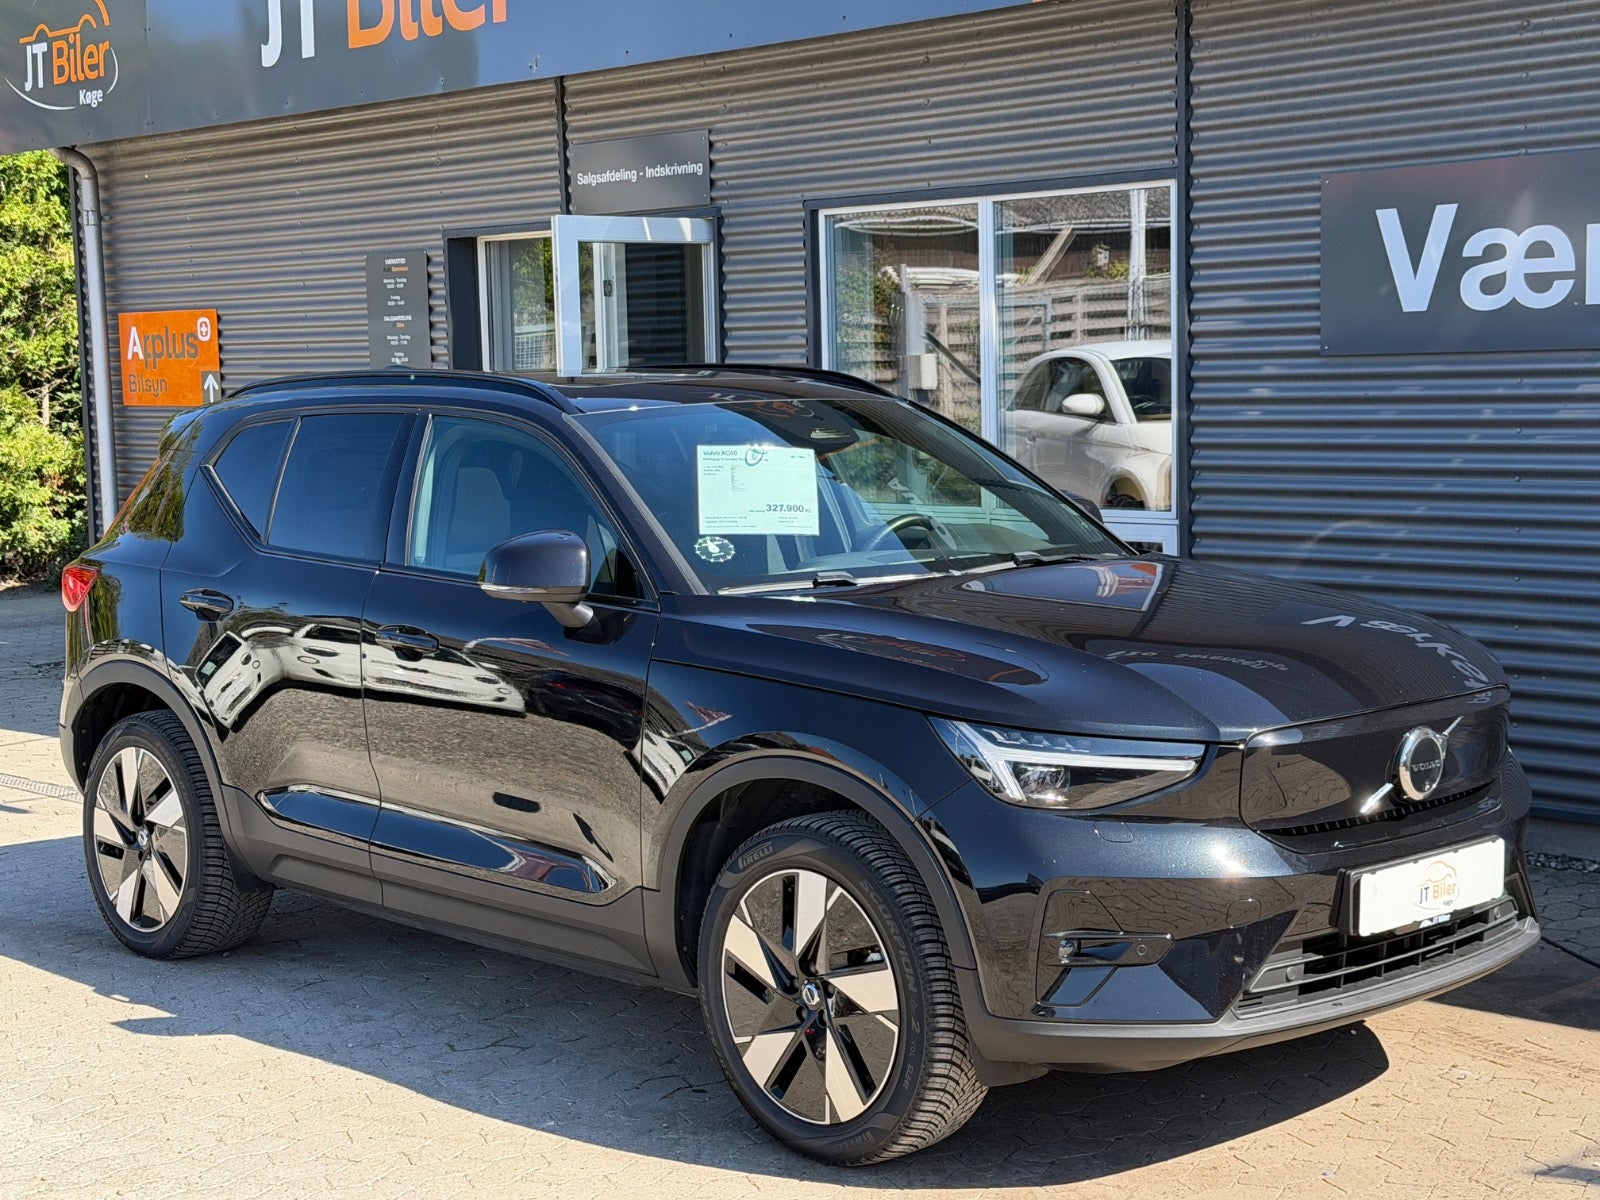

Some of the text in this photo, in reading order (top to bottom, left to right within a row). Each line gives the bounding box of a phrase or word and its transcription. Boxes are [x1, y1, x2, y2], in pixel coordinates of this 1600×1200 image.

[25, 33, 110, 92] JT Biler
[79, 89, 104, 107] Køge
[577, 168, 637, 186] Salgsafdeling
[645, 161, 703, 179] Indskrivning
[128, 373, 168, 398] Bilsyn
[766, 504, 805, 512] 327.900
[1411, 760, 1441, 773] VOLVO
[738, 841, 773, 869] PIRELLI
[1419, 881, 1457, 905] JT Biler
